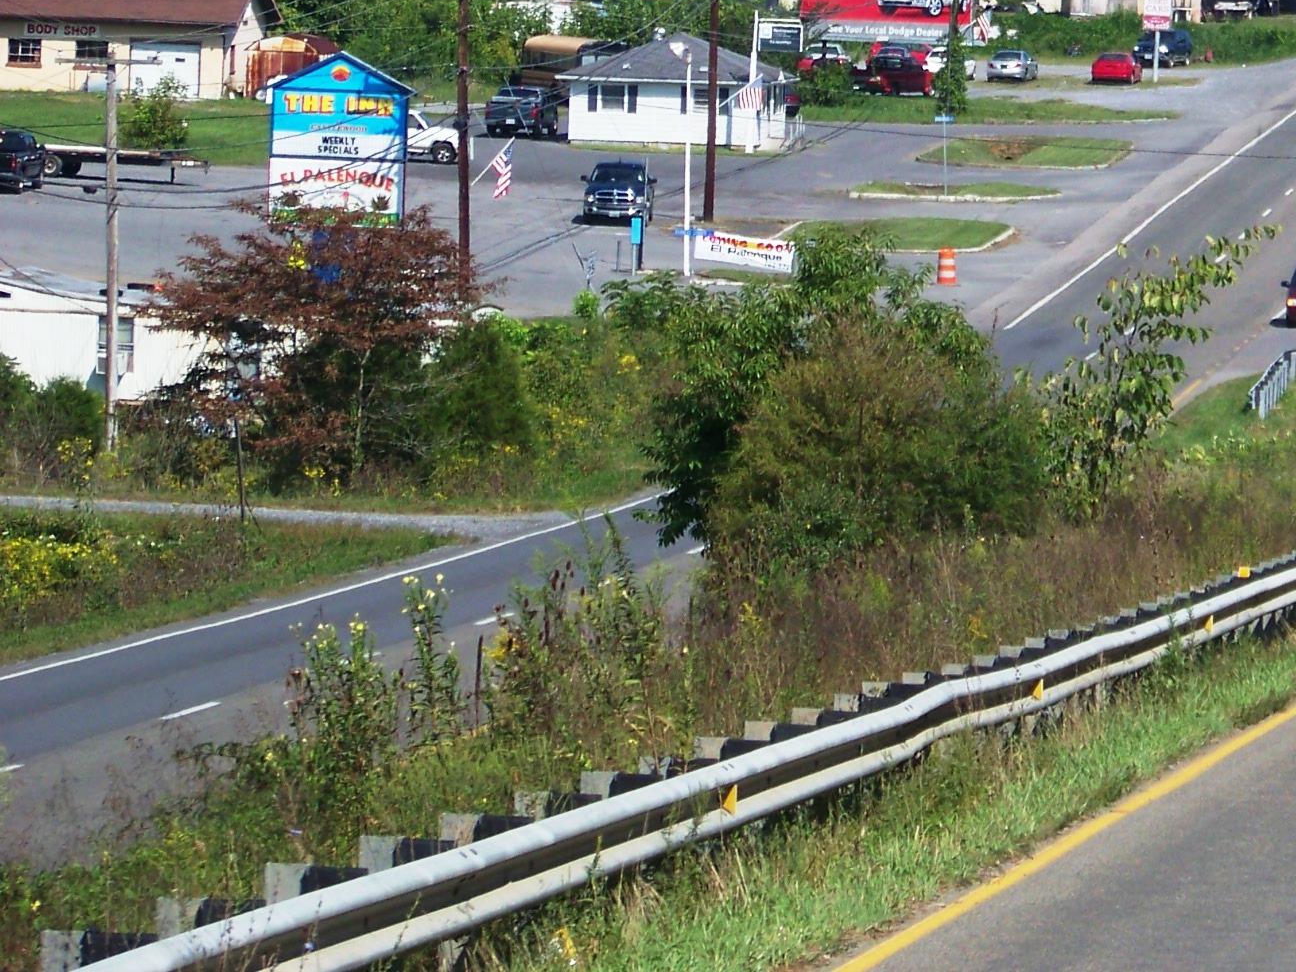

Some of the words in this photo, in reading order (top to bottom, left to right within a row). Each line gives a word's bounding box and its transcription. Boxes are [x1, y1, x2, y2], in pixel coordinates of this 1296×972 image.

[27, 24, 59, 34] BODY
[64, 25, 97, 37] SHOP
[828, 25, 843, 34] See
[845, 25, 863, 34] Your
[865, 26, 886, 35] Local
[889, 27, 914, 38] Dodge
[916, 28, 943, 37] Dealer
[284, 93, 335, 114] THE
[322, 136, 356, 146] WEEKLY
[317, 145, 359, 155] SPECIALS
[280, 171, 296, 187] EL
[303, 168, 395, 192] PALENQUE
